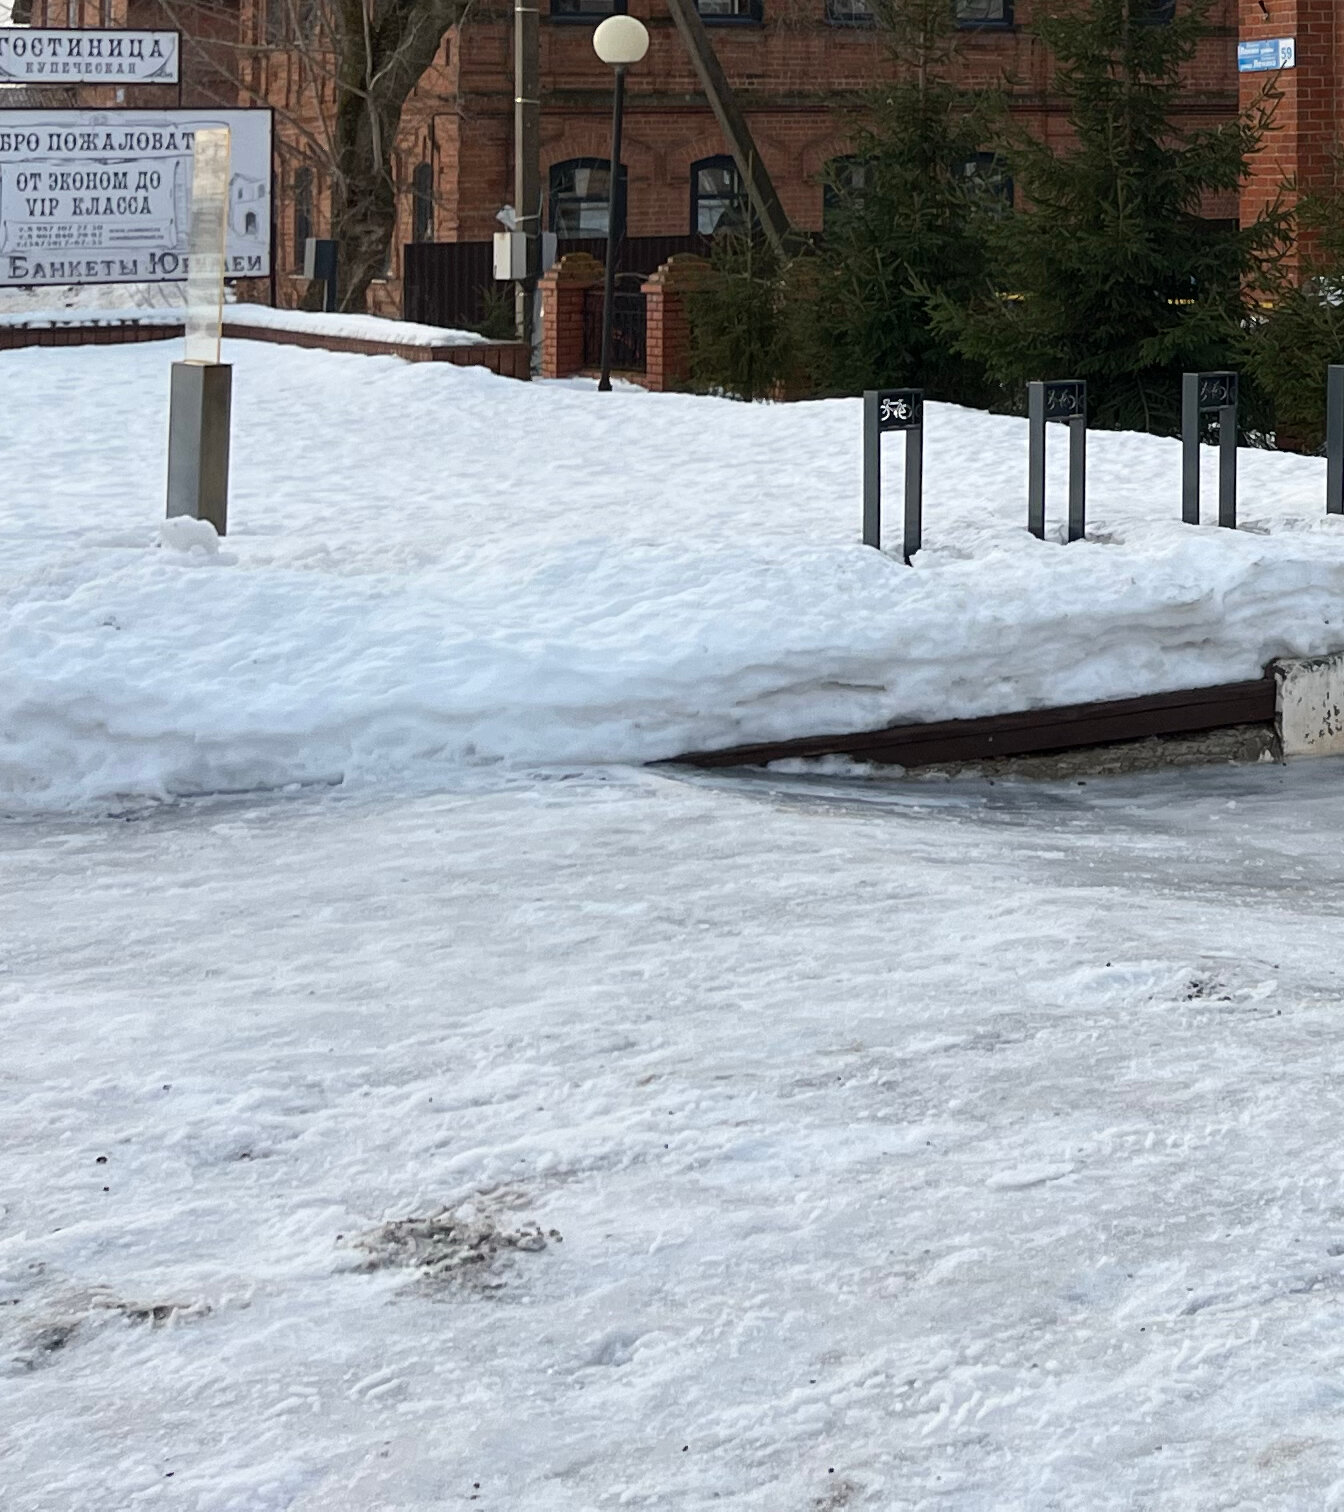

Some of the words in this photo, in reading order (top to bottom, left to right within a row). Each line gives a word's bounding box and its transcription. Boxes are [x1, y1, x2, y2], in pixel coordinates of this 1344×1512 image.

[0, 37, 164, 61] ГОСТИНИЦА
[1281, 46, 1292, 60] 59
[48, 131, 195, 153] ПОЖАЛОВАТ
[16, 172, 42, 192] ОТ
[49, 171, 128, 192] ЭКОНОМ
[135, 170, 161, 194] ДО
[26, 198, 59, 217] VIP
[72, 197, 152, 216] КЛАССА
